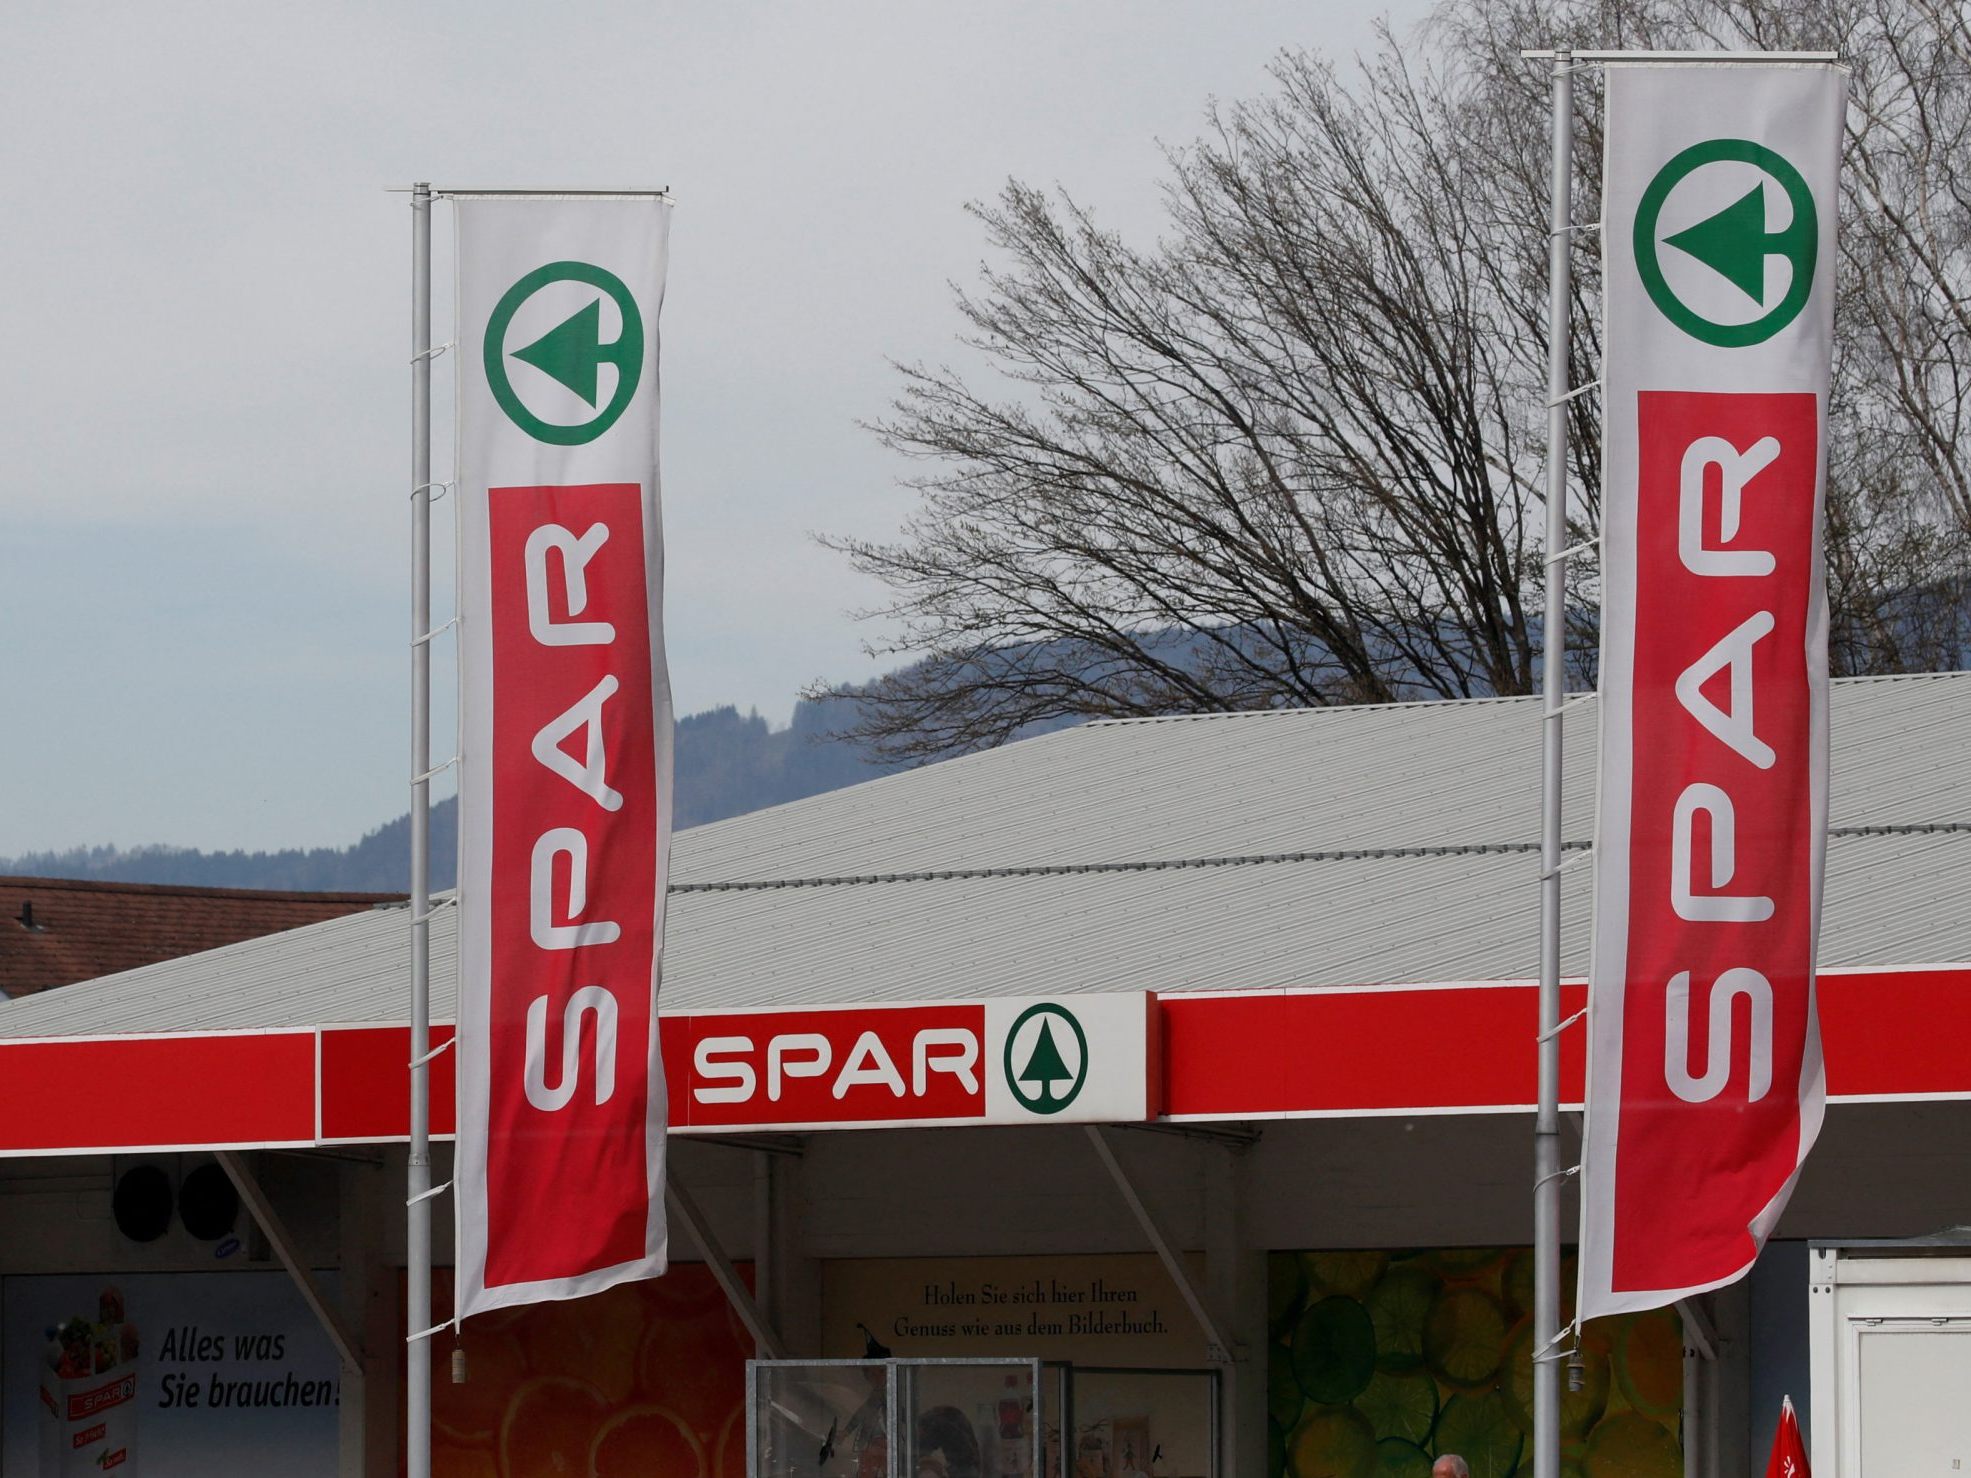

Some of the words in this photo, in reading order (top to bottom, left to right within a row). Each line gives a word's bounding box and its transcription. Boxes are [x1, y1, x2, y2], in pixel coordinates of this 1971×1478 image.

[1665, 435, 1781, 1103] SPAR
[524, 522, 624, 1112] SPAR
[693, 1028, 979, 1104] SPAR
[924, 1281, 975, 1305] Holen
[981, 1284, 1008, 1305] Sie
[1012, 1280, 1046, 1304] sich
[1051, 1279, 1086, 1304] hier
[1091, 1279, 1137, 1303] Ihren
[894, 1316, 956, 1337] Genuss
[962, 1317, 990, 1336] wie
[995, 1321, 1022, 1336] aus
[1027, 1312, 1062, 1336] dem
[1068, 1310, 1169, 1335] Bilderbuch.
[159, 1326, 225, 1362] Alles
[234, 1333, 285, 1361] was
[84, 1387, 121, 1410] SPAR
[158, 1372, 201, 1409] Sie
